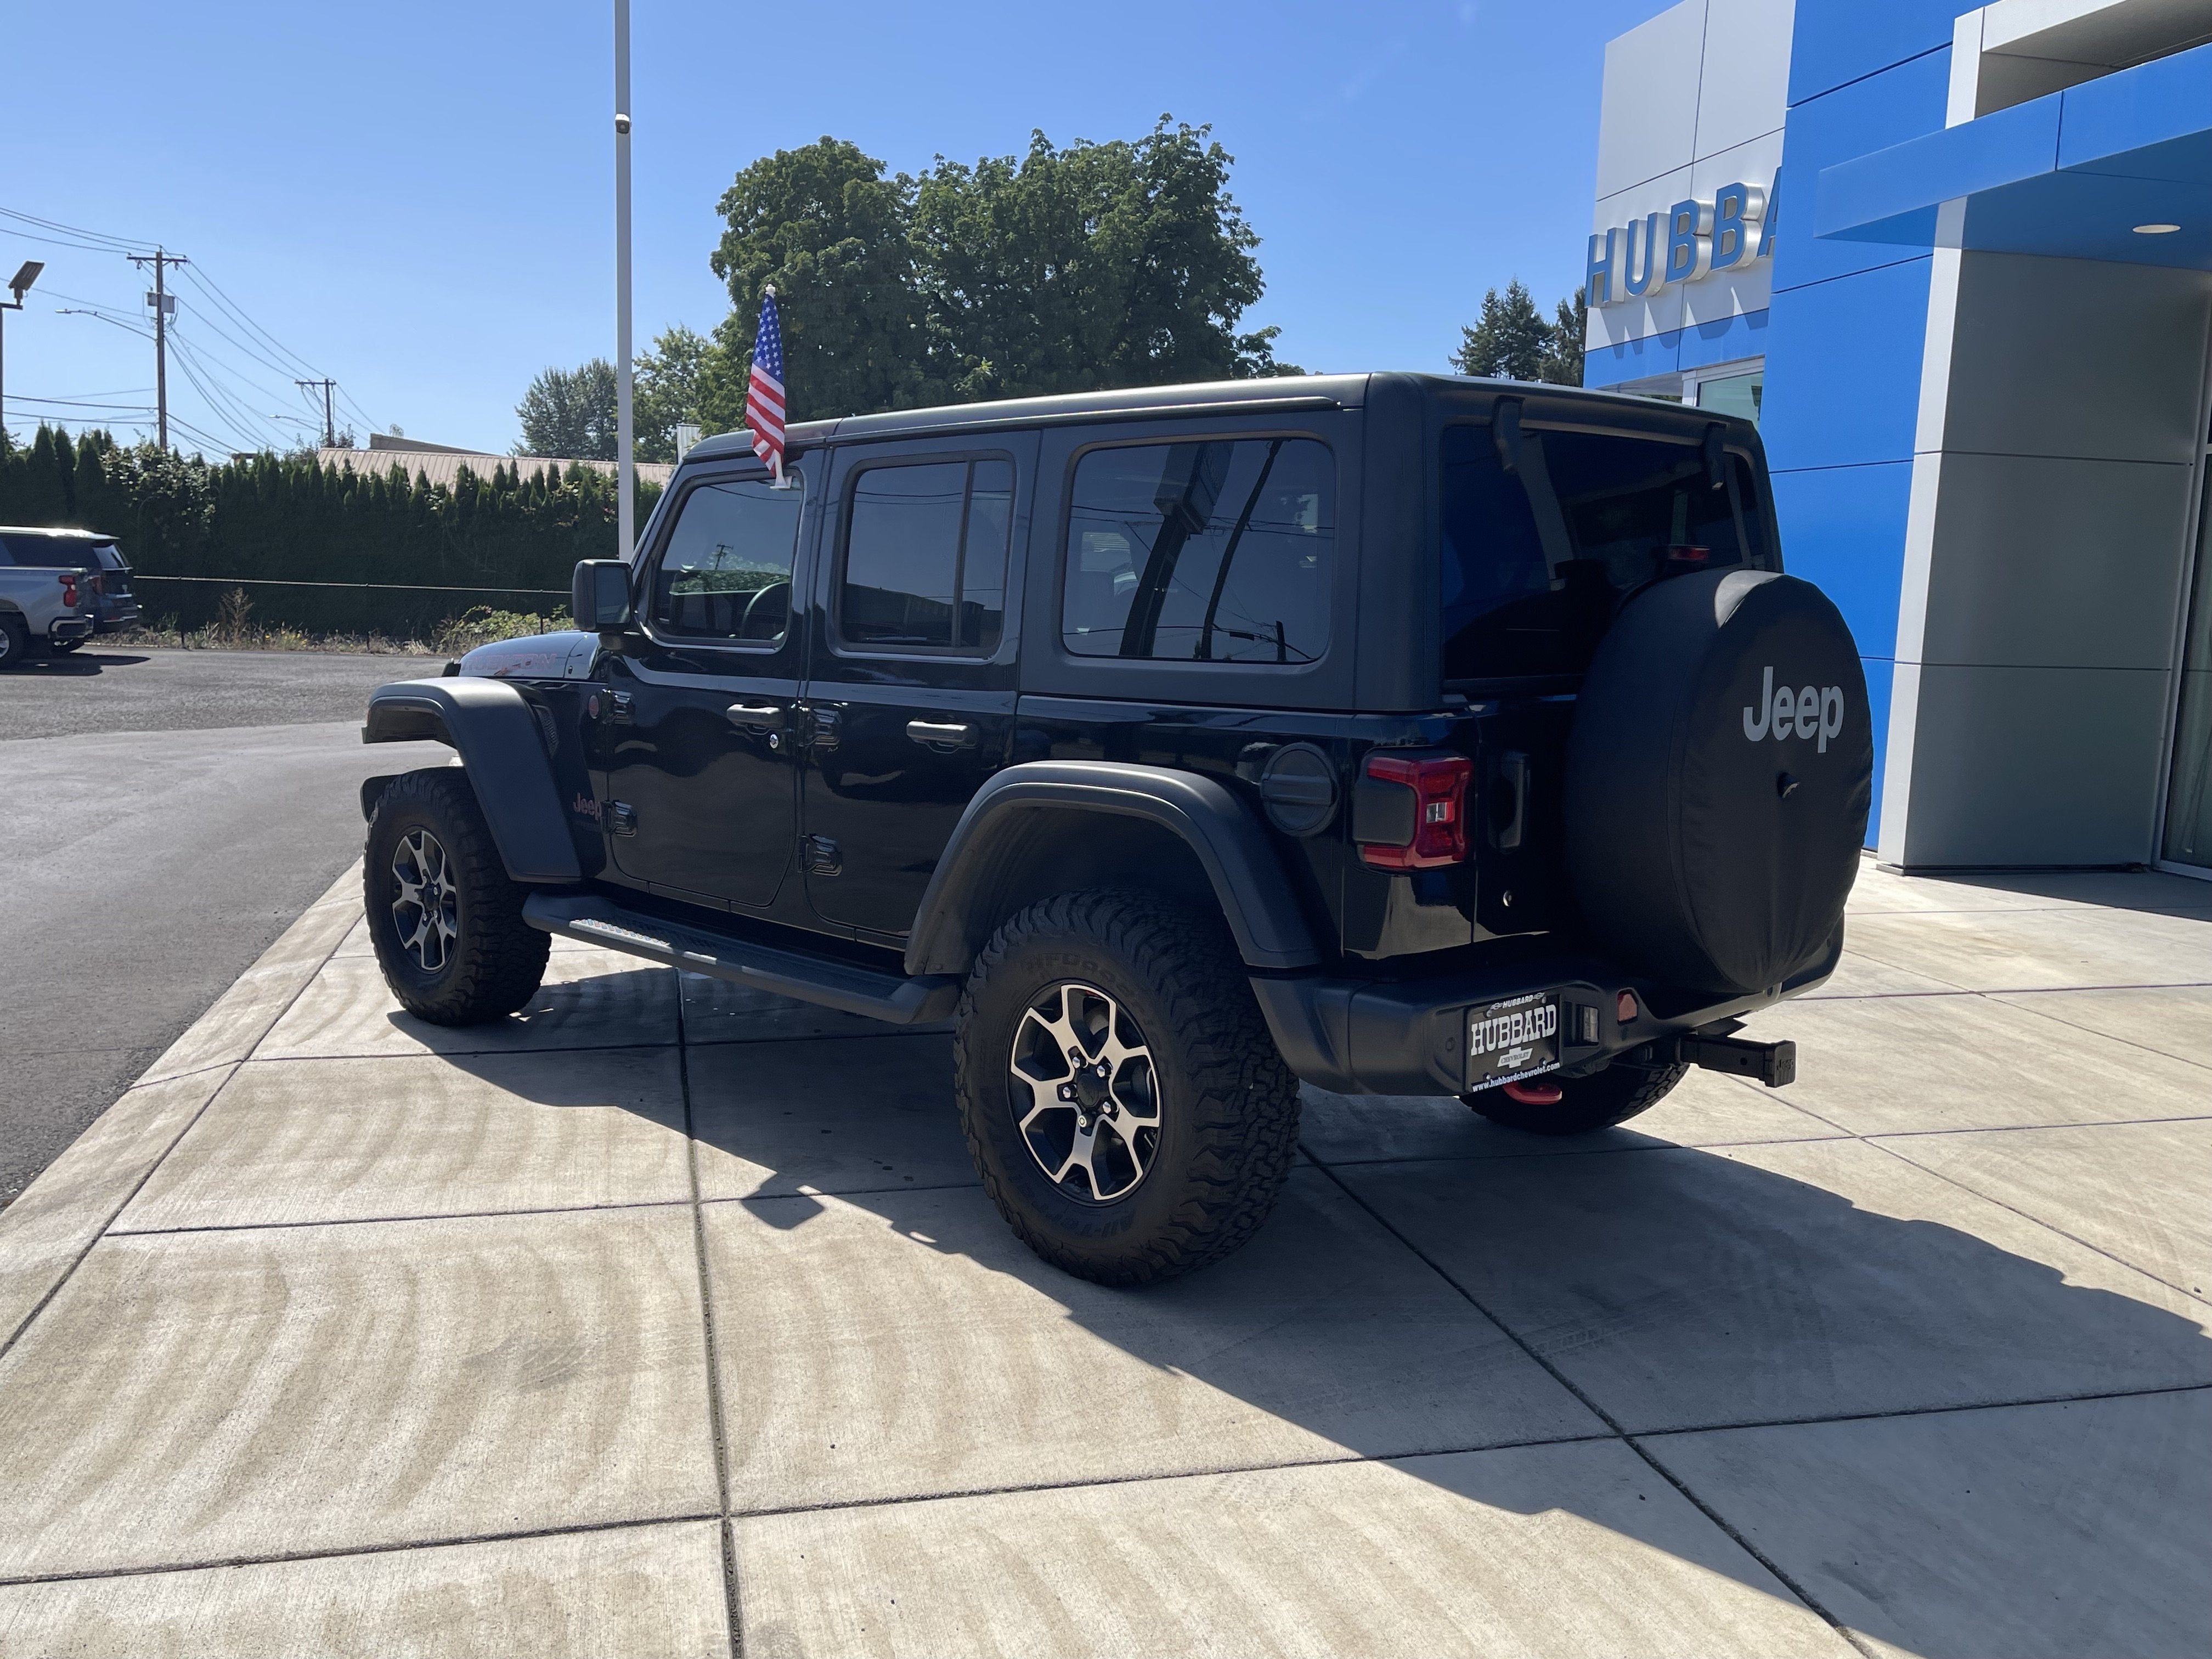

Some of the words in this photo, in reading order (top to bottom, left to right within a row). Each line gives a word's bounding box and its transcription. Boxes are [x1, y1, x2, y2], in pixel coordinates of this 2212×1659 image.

[1743, 666, 1844, 753] Jeep
[573, 792, 602, 821] Jeep
[1502, 995, 1533, 1008] HUBBARD
[1471, 1004, 1556, 1056] HUBBARD
[1501, 1051, 1529, 1064] CHEVROLET
[1472, 1062, 1560, 1092] www.hubbardchevrolet.com
